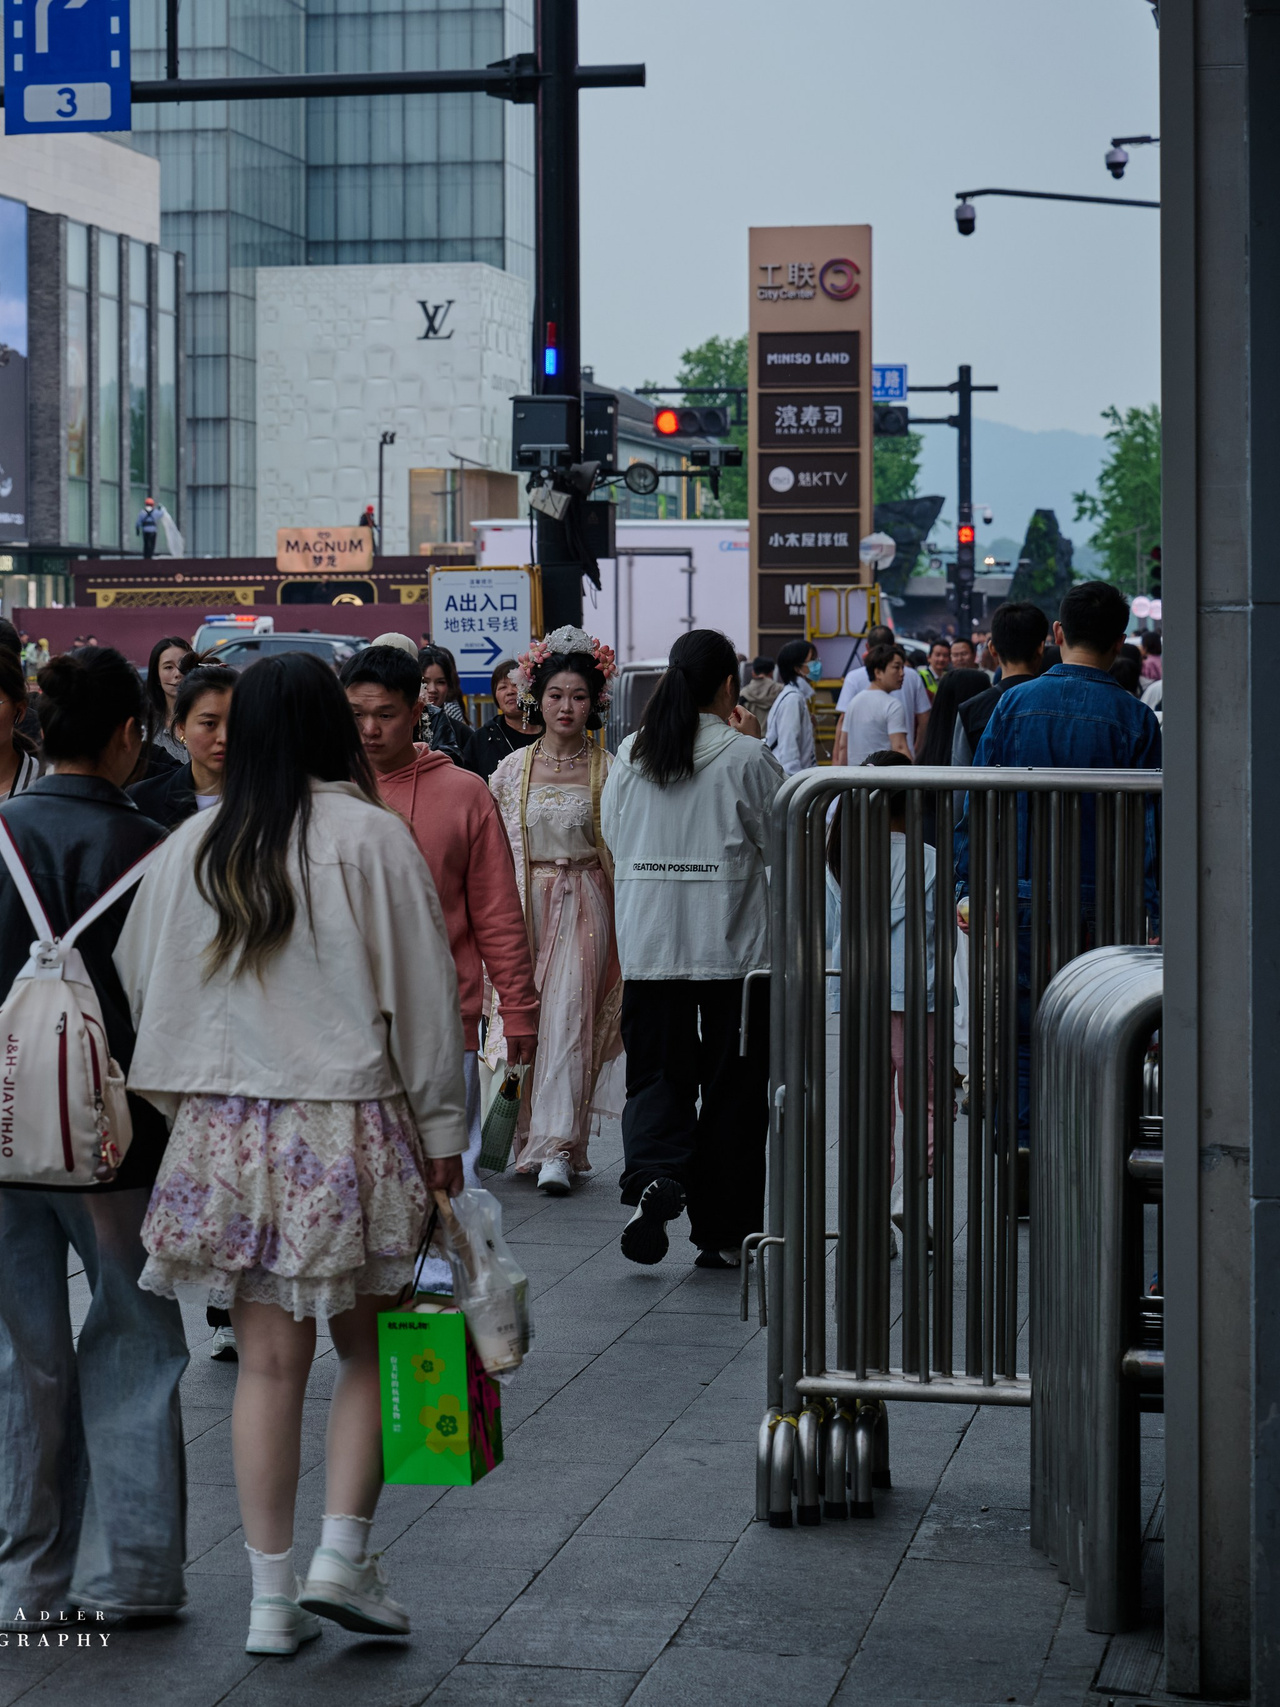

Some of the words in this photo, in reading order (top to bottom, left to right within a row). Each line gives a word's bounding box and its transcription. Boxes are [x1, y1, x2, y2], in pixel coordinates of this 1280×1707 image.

[56, 88, 77, 118] 3
[758, 263, 816, 289] 工联
[767, 353, 812, 365] MINISO
[815, 352, 850, 365] LAND
[285, 539, 363, 553] MAGNUM
[445, 593, 517, 612] A出入口
[444, 617, 518, 633] 地铁1号线
[668, 864, 719, 872] POSSIBILITY
